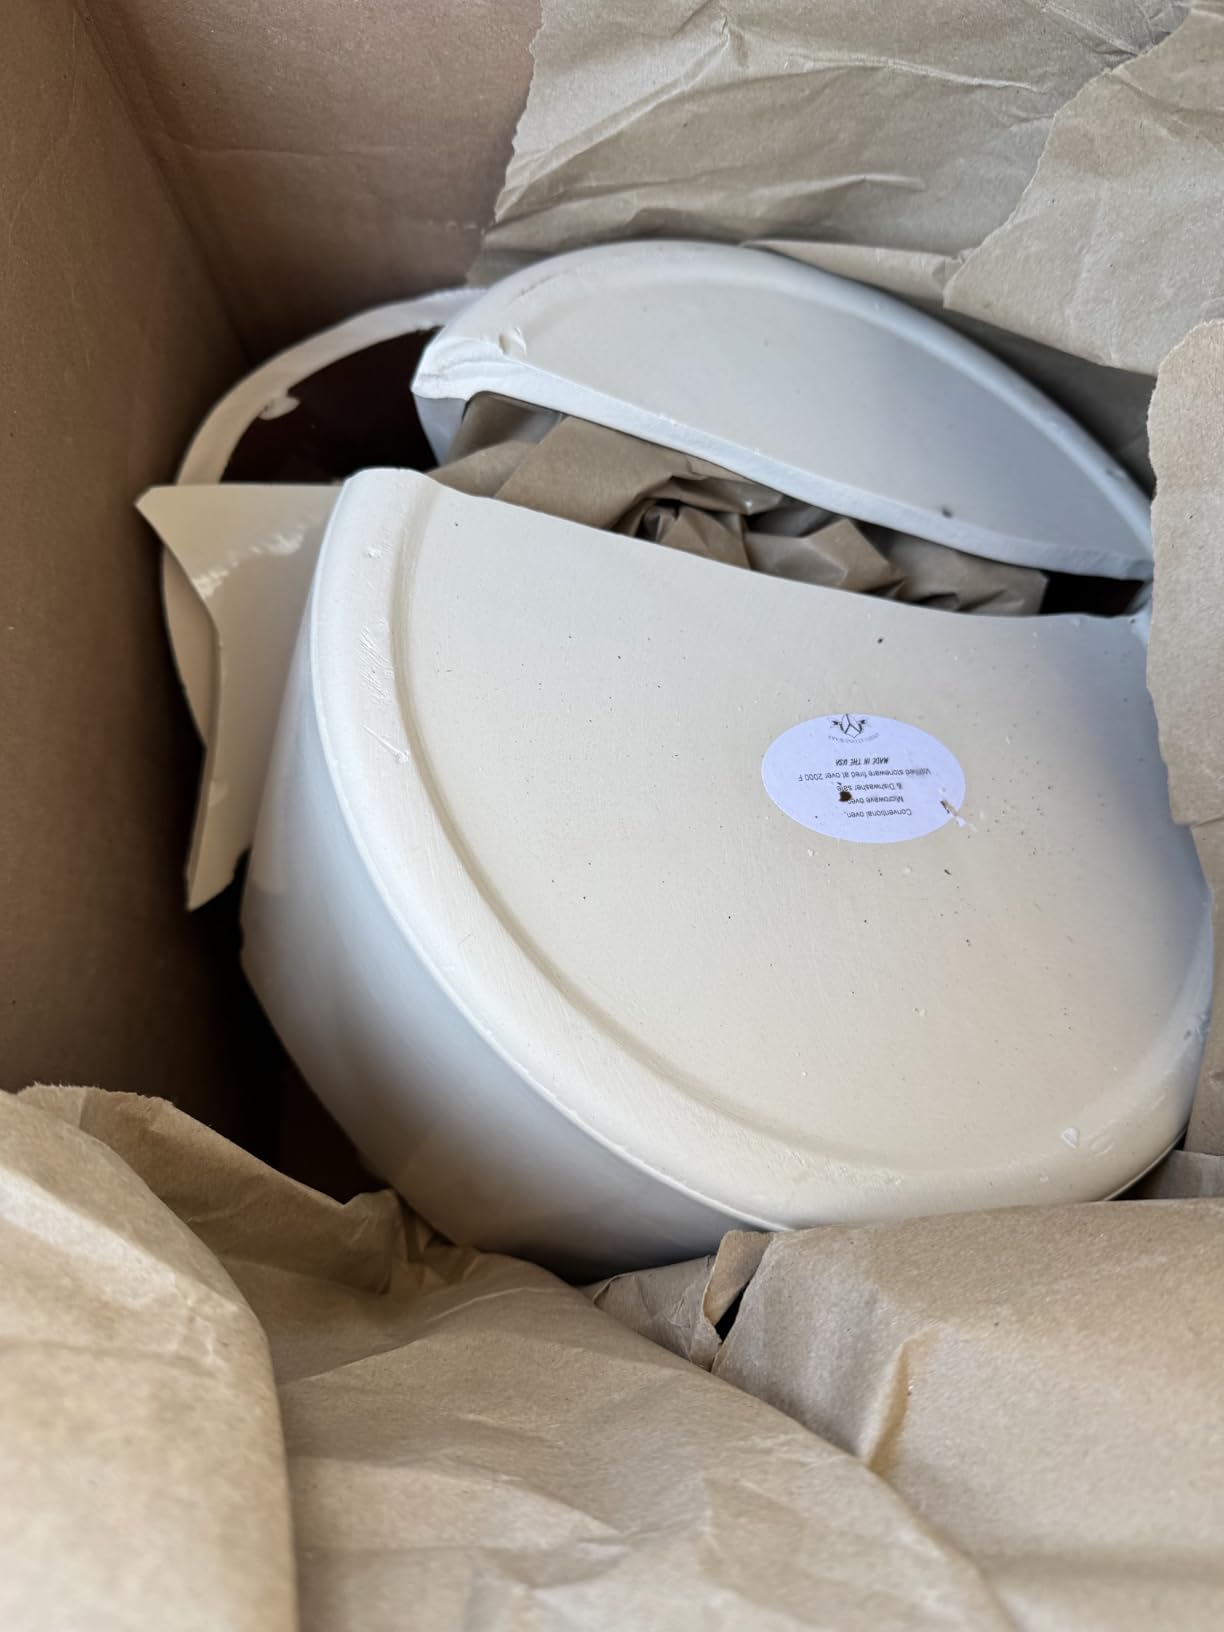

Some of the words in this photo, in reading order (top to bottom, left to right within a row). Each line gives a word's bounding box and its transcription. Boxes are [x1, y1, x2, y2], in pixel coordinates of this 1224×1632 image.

[835, 758, 848, 766] USA
[850, 758, 862, 766] THE
[872, 757, 889, 765] MADE
[851, 770, 867, 778] fired
[868, 768, 904, 776] stoneware
[804, 773, 823, 781] 2000
[855, 782, 897, 791] Dishwasher
[865, 796, 904, 804] Microwave
[866, 808, 912, 818] Conventional
